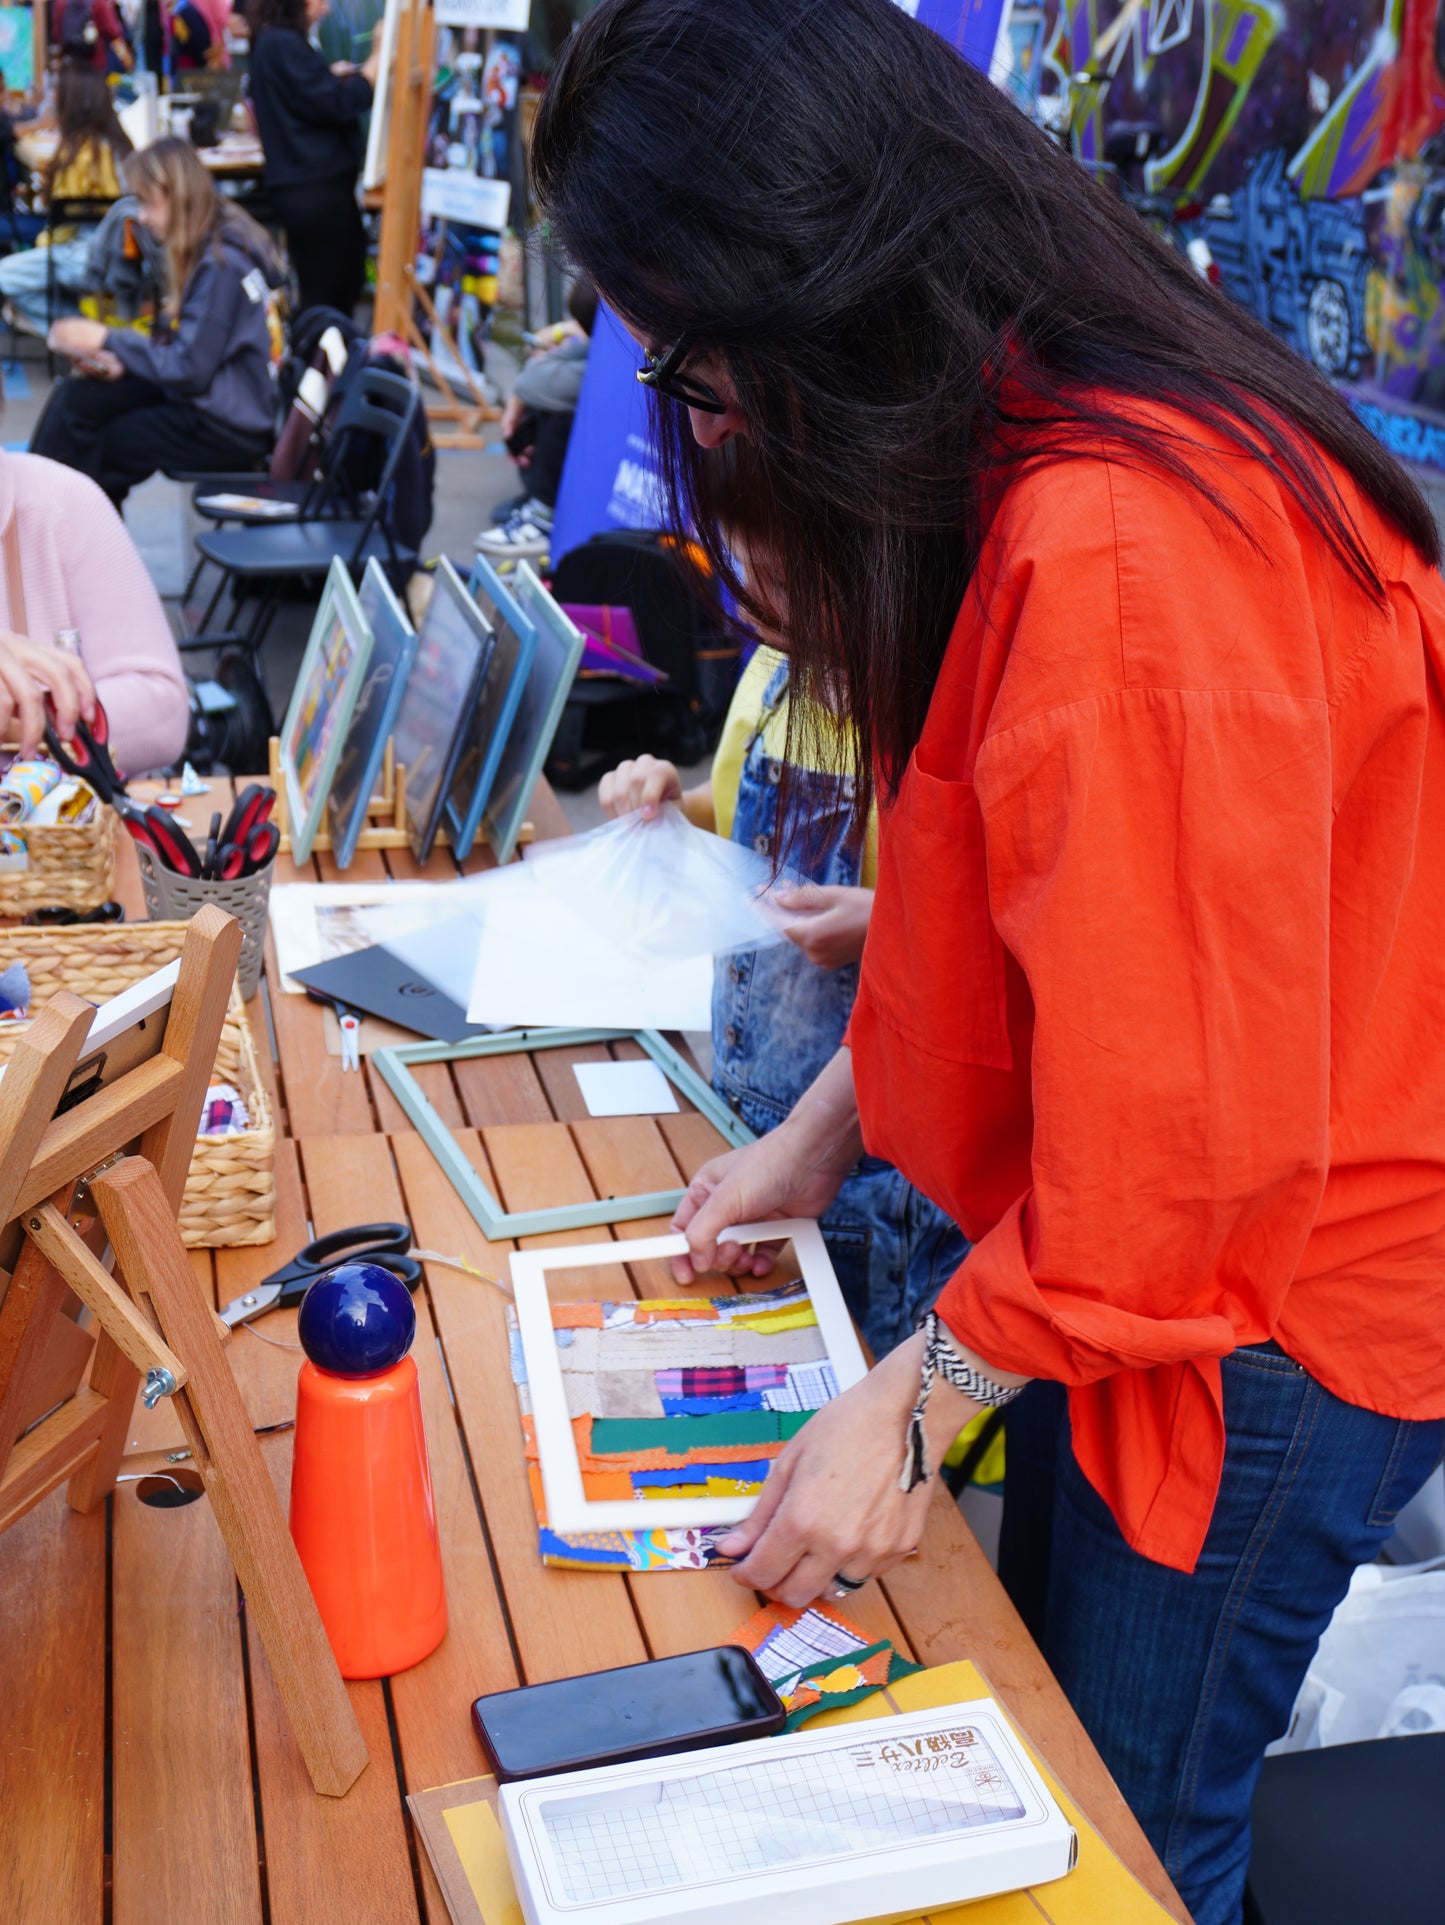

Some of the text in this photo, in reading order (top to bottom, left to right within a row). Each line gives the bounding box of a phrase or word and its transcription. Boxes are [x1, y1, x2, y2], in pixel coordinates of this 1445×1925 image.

[851, 1730, 979, 1767] 高級ハサミ
[892, 1751, 970, 1773] Belltex
